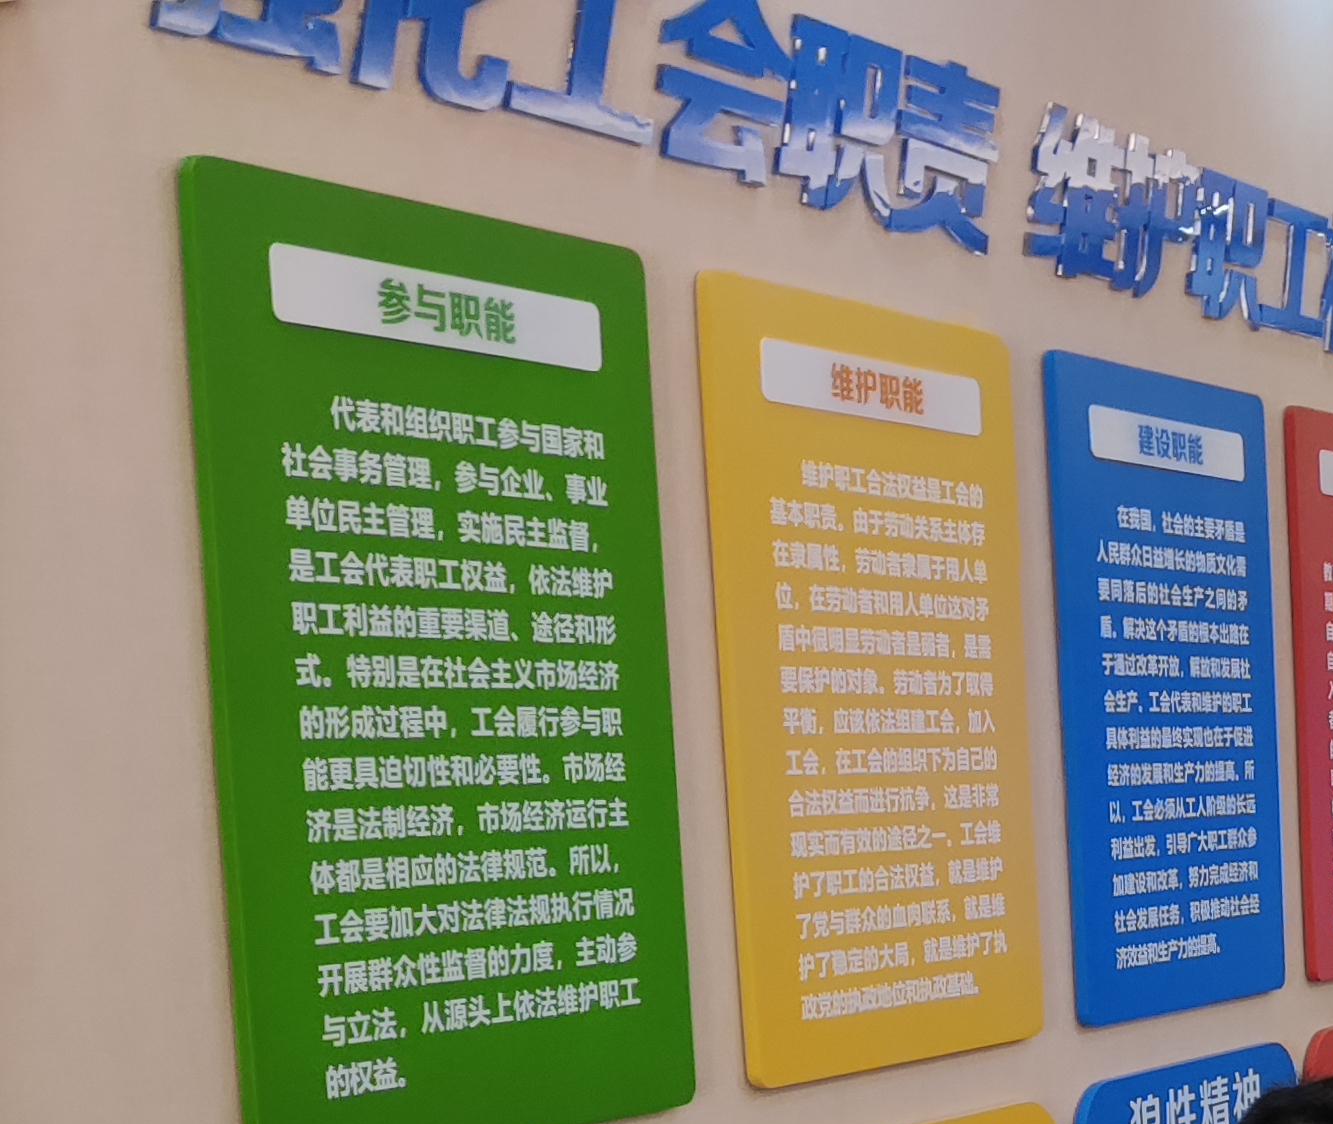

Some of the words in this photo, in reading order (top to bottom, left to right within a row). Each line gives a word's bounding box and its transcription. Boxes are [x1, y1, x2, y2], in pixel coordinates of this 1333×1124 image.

[378, 278, 516, 345] 参与职能
[831, 362, 924, 414] 维护职能
[1138, 425, 1204, 465] 建设职能
